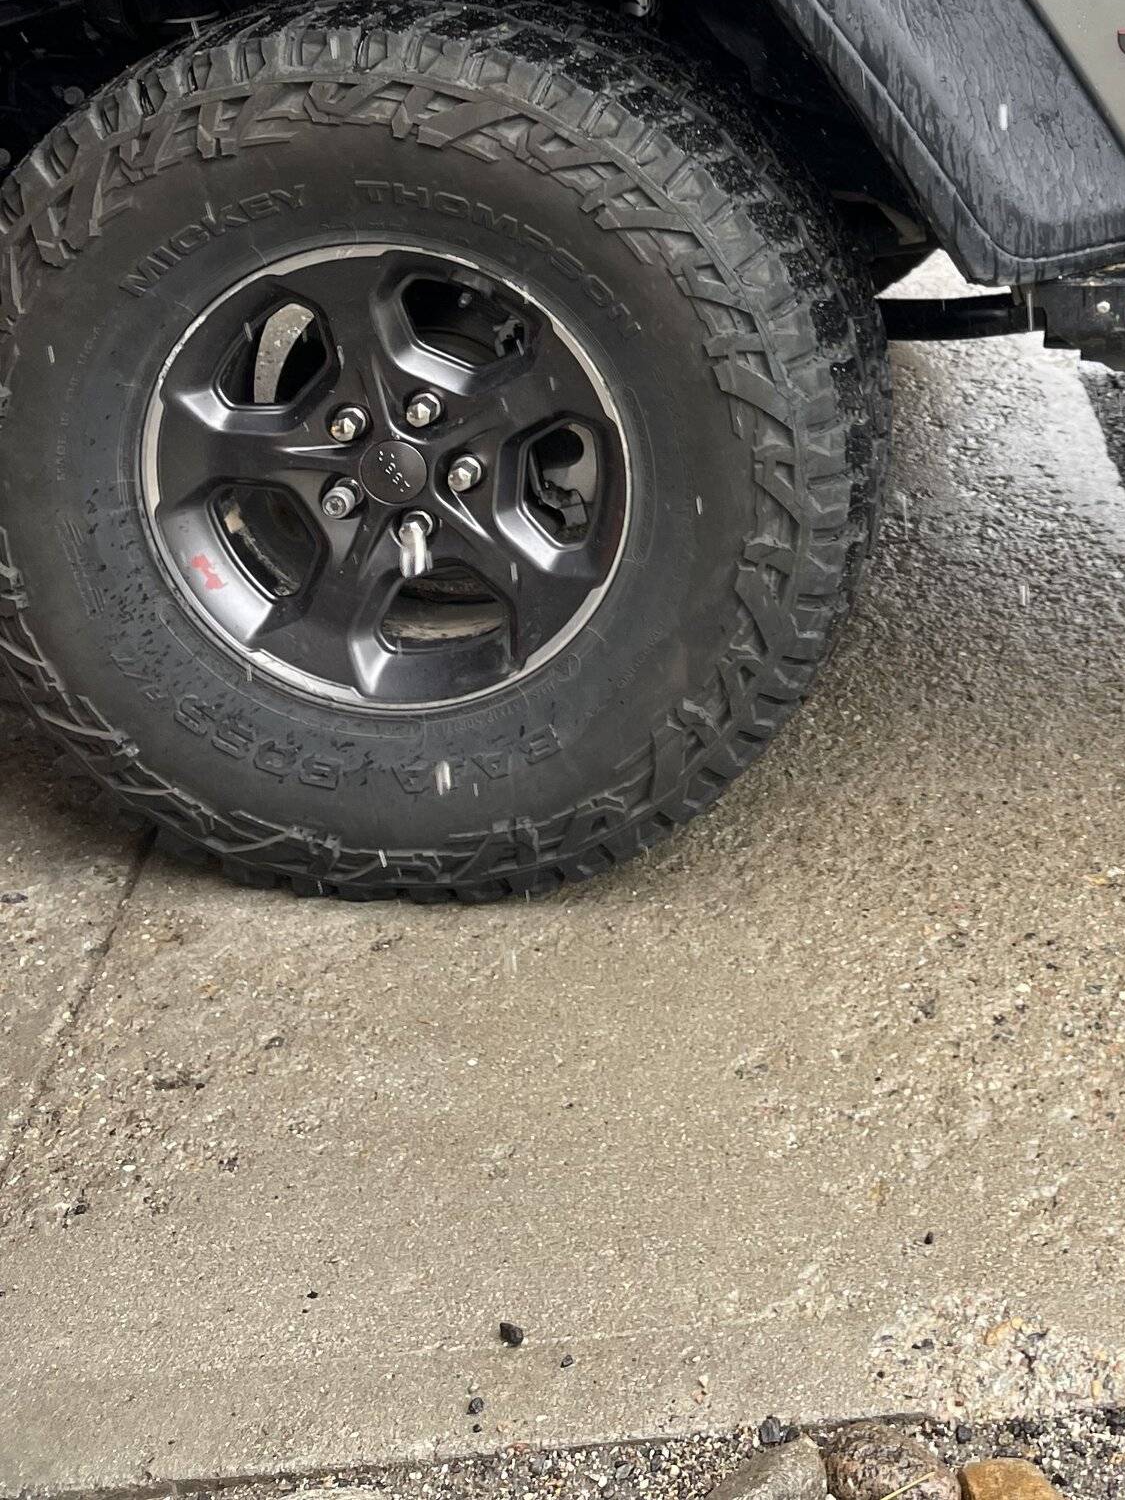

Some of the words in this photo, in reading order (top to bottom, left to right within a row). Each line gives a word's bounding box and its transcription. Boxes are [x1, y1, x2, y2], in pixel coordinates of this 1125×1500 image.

[119, 184, 305, 297] MICKEY
[354, 180, 642, 336] THOMPSON
[174, 695, 342, 790] BOSS
